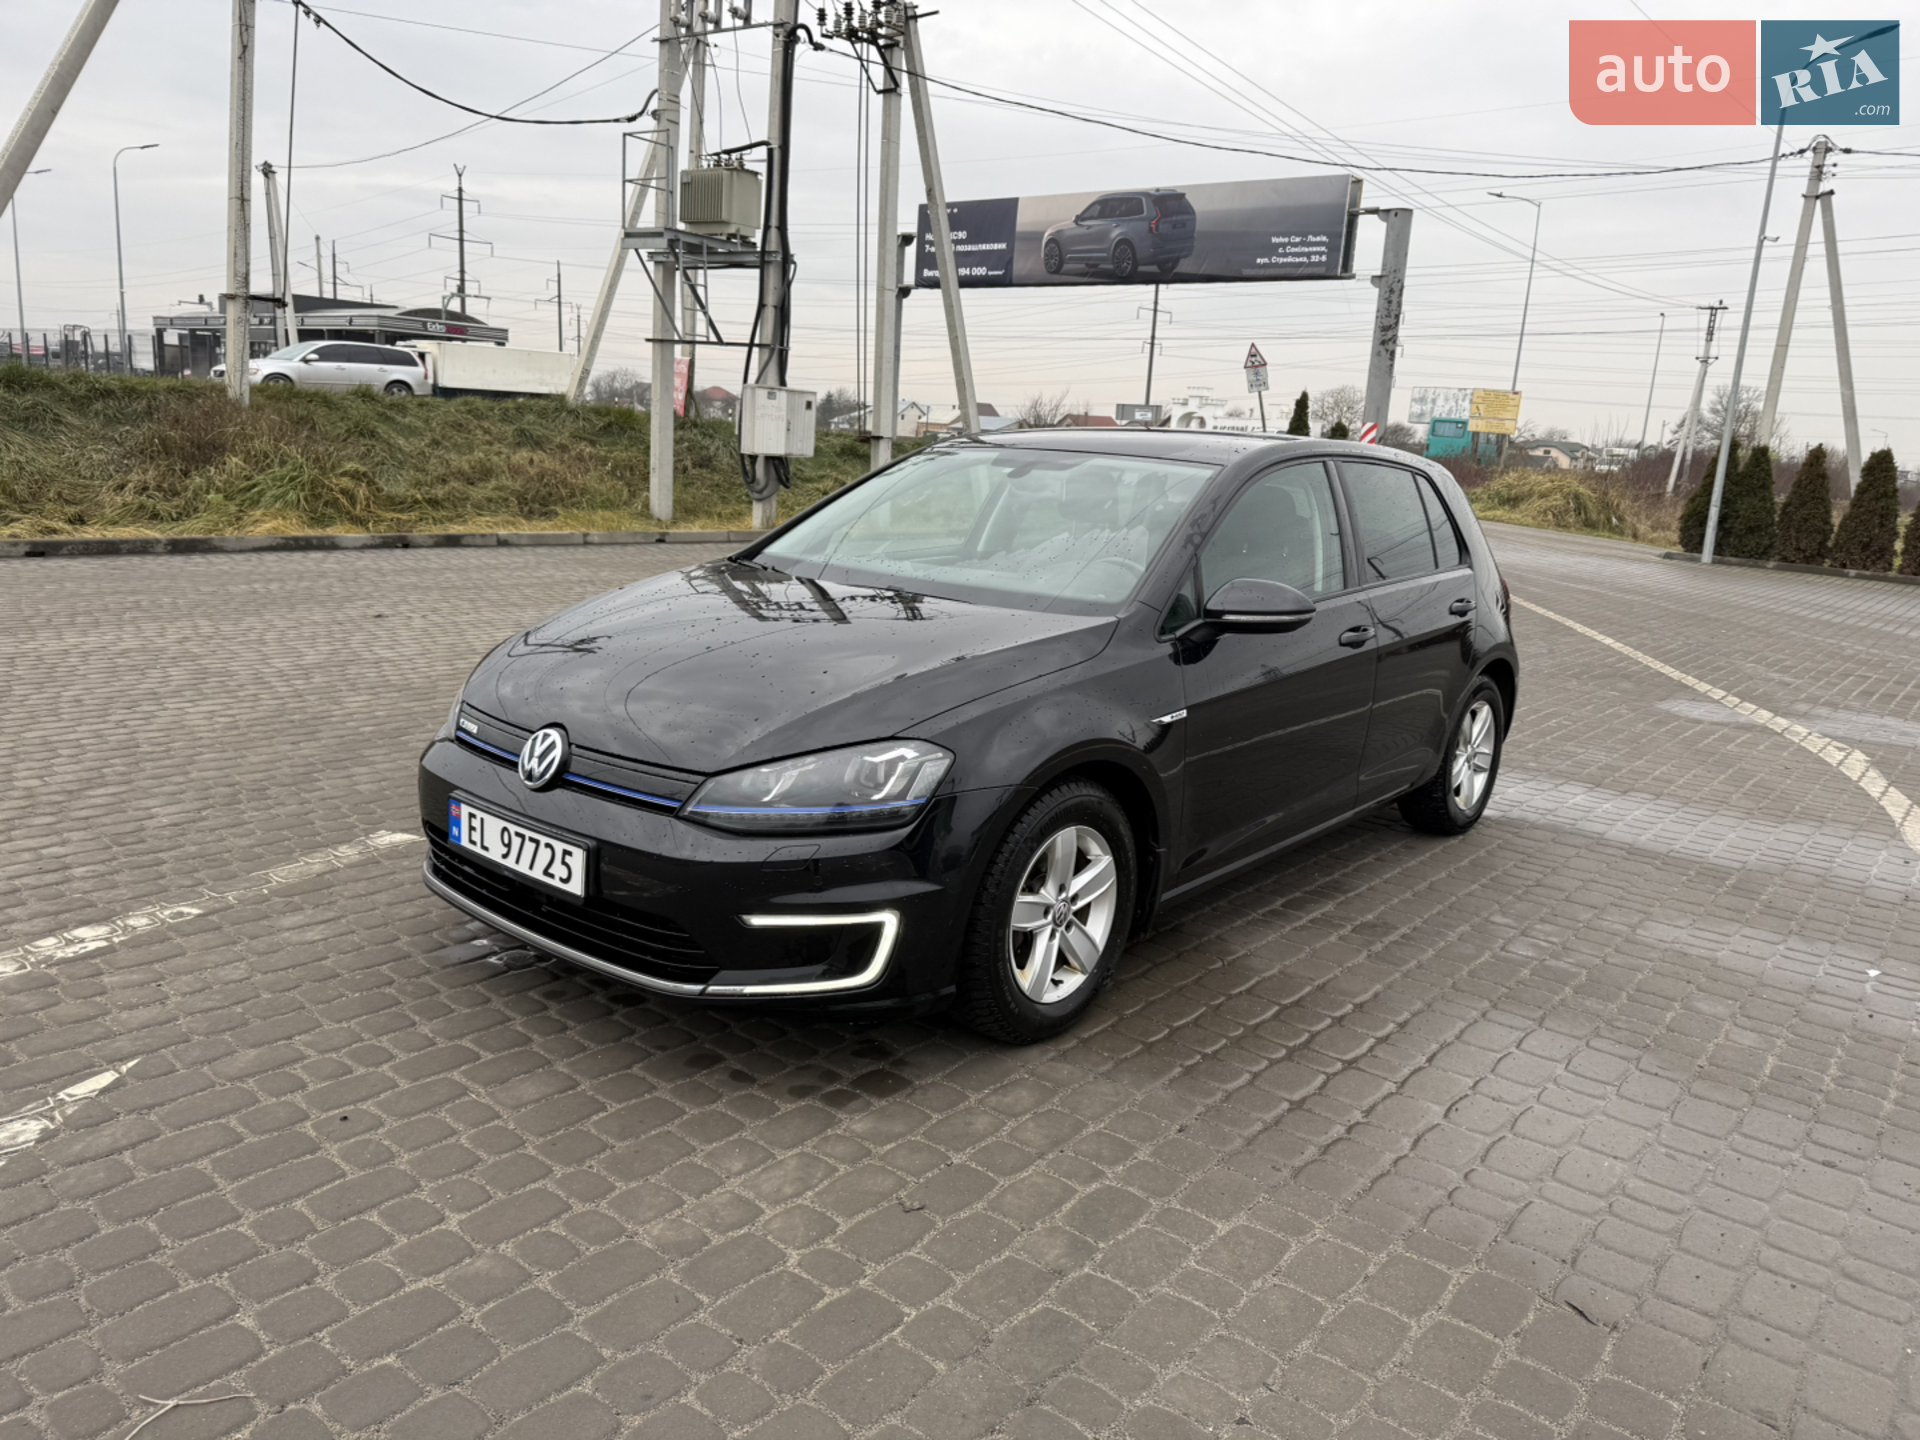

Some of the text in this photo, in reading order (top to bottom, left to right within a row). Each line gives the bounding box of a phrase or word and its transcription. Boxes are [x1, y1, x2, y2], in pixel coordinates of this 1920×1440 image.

[958, 267, 970, 276] 194
[971, 267, 987, 276] 000
[467, 811, 490, 853] EL
[500, 829, 573, 885] 97725
